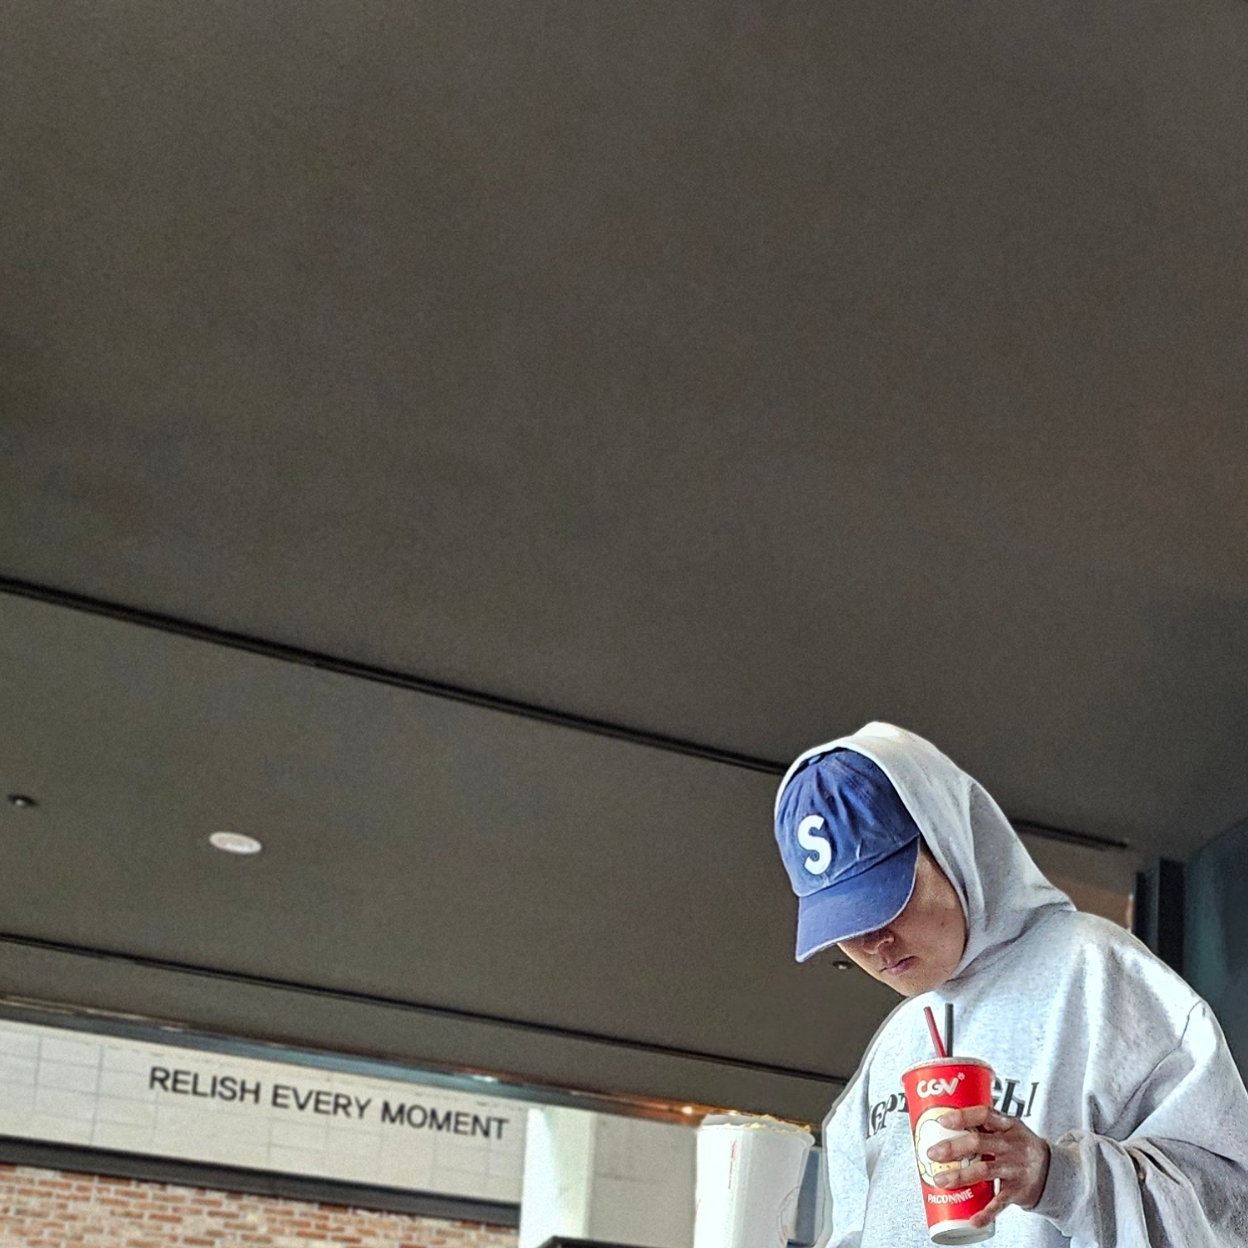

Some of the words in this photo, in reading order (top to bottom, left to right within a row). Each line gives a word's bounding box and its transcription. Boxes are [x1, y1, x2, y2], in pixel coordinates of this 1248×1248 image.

[797, 814, 832, 876] S
[149, 1066, 262, 1105] RELISH
[271, 1085, 372, 1119] EVERY
[381, 1102, 510, 1140] MOMENT
[917, 1077, 961, 1099] CGV
